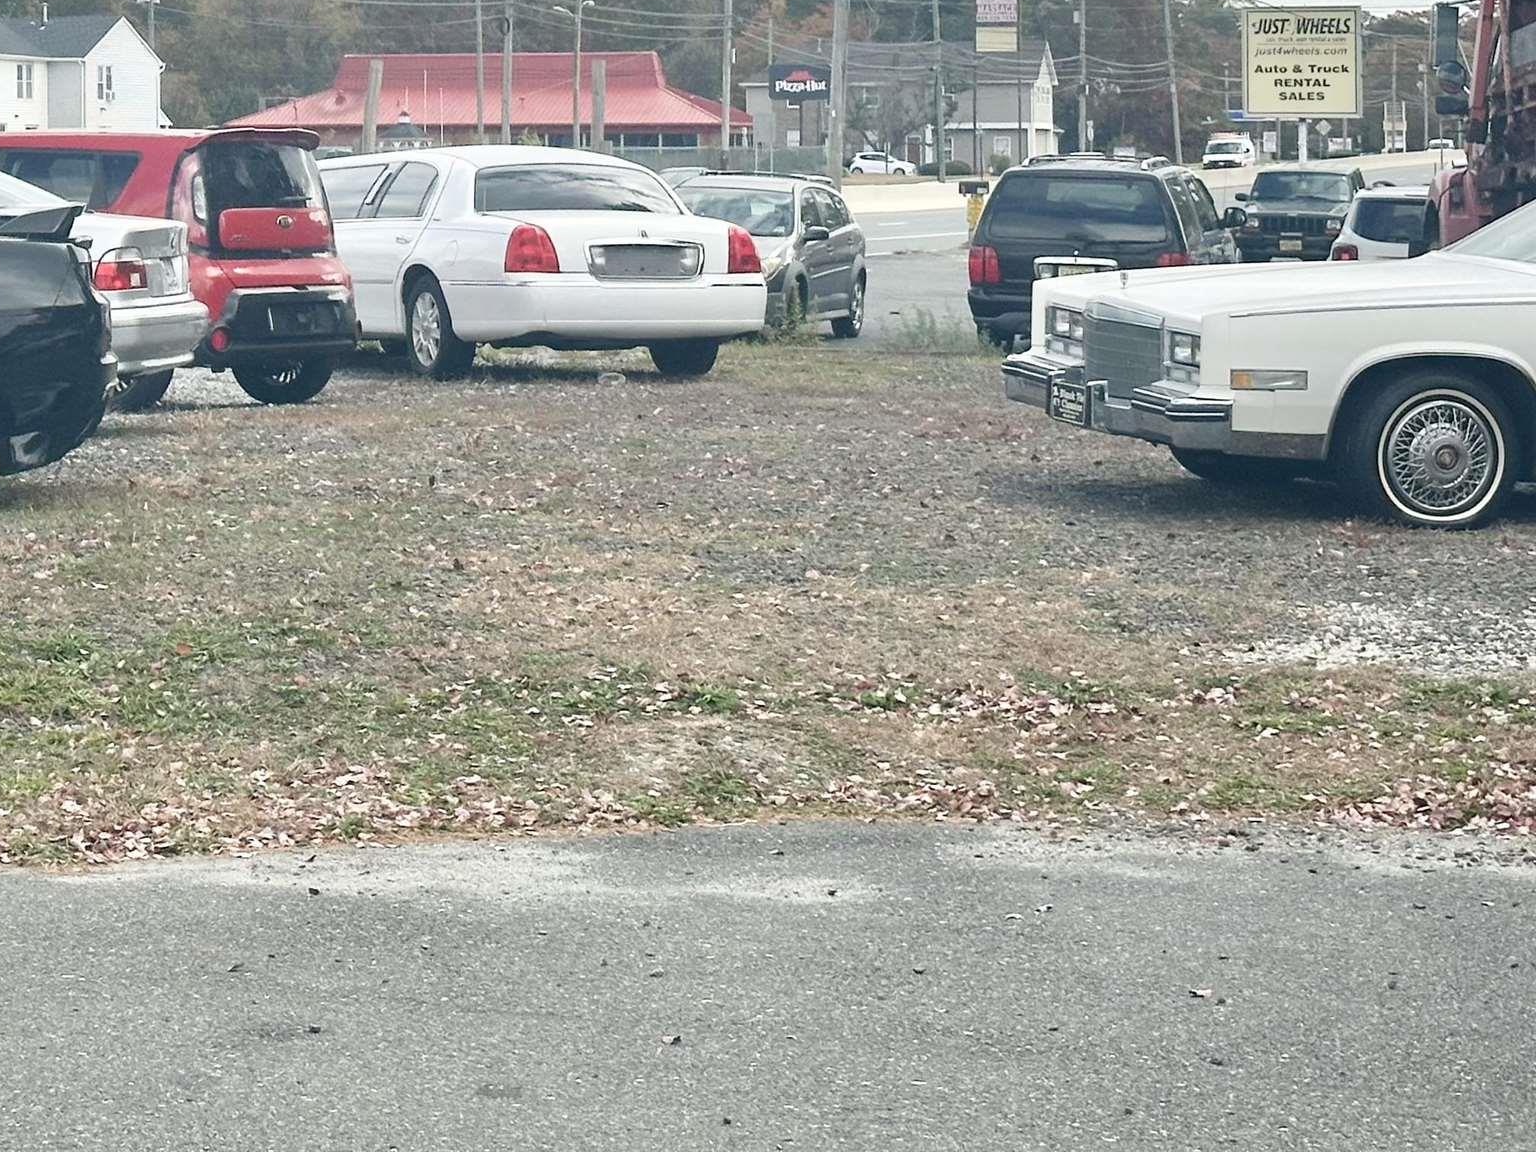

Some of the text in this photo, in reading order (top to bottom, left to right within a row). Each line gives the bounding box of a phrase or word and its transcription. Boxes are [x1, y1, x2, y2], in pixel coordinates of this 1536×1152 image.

[1254, 17, 1352, 35] JUST WHEELS
[1254, 47, 1348, 57] just4wheels.com
[1254, 64, 1350, 74] Auto & Truck
[1274, 79, 1331, 88] RENTAL
[1279, 92, 1325, 101] SALES
